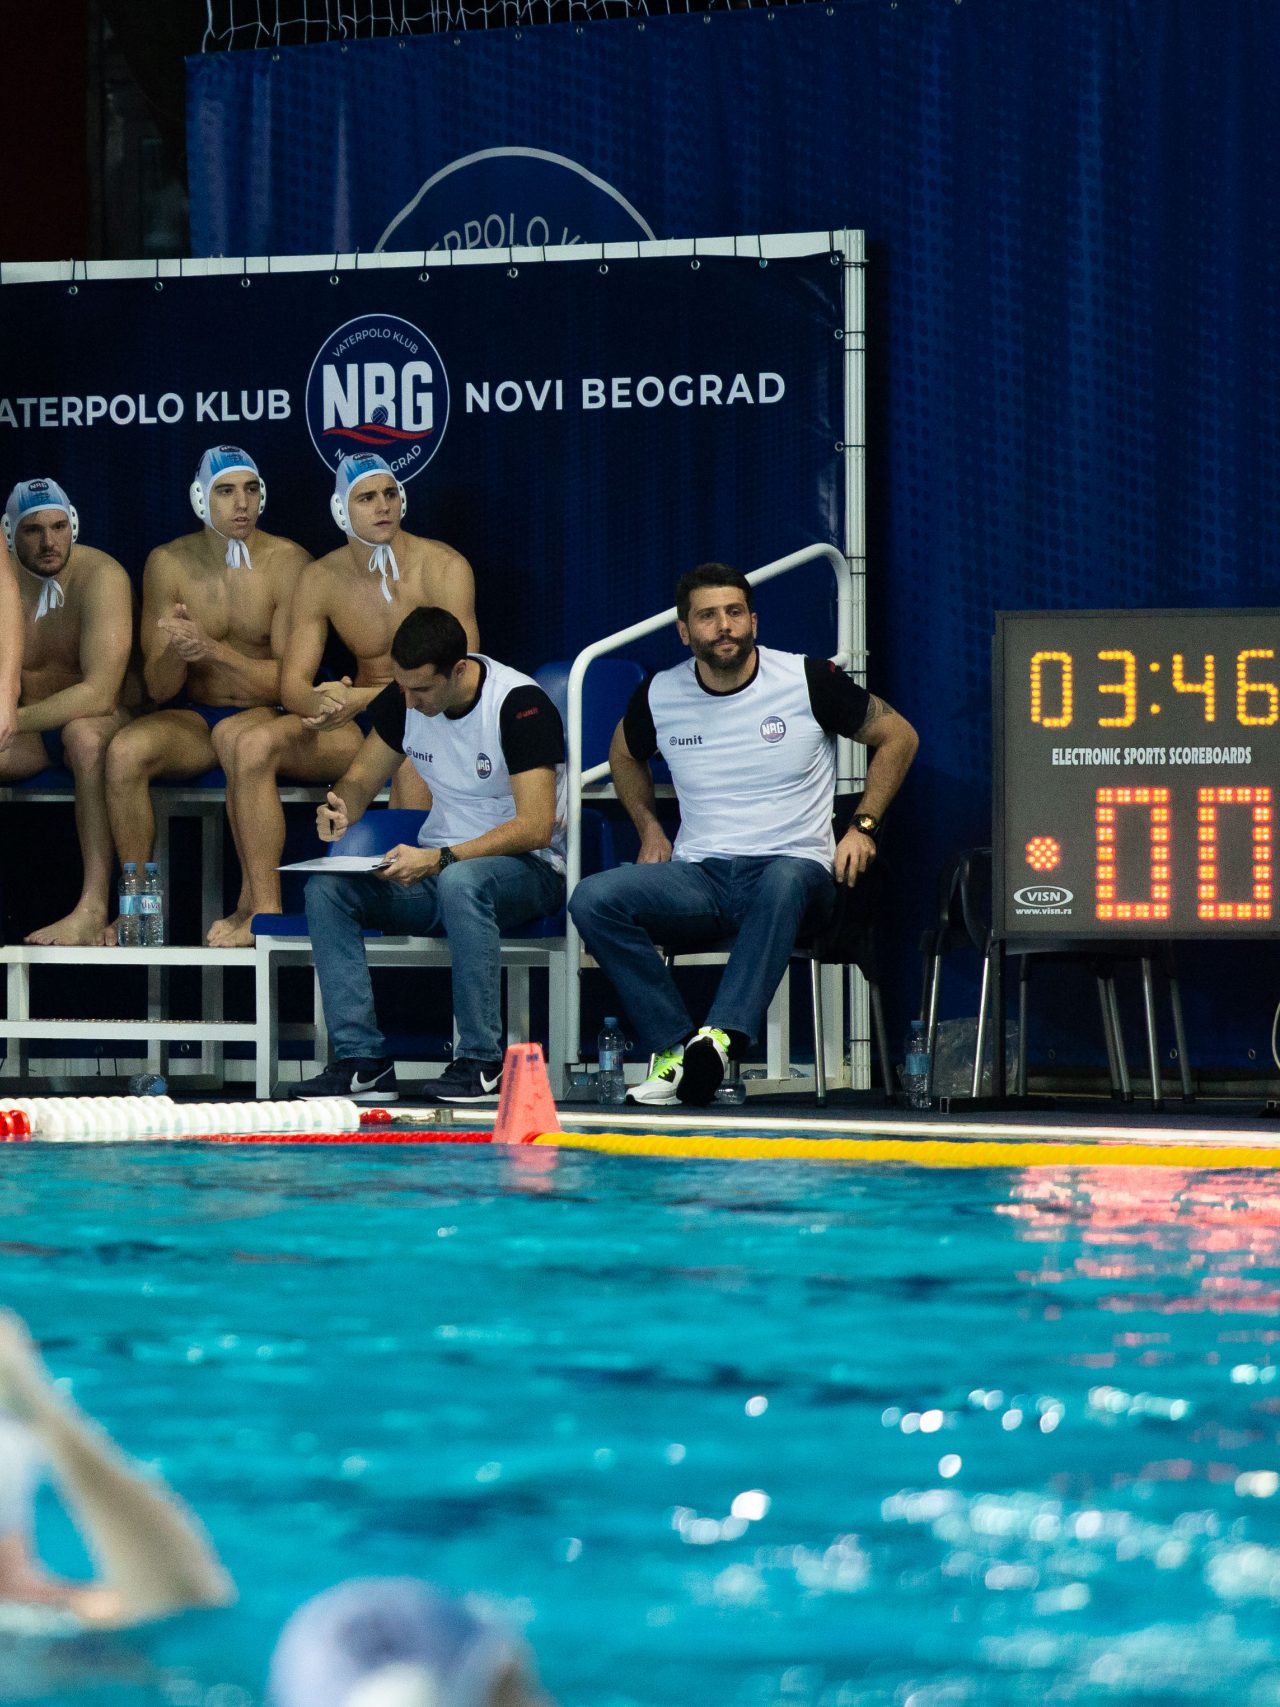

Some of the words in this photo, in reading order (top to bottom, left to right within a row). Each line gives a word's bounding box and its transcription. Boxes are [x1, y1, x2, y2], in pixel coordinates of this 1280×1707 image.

[332, 328, 391, 357] VATERPOLO
[393, 331, 419, 355] KLUB
[322, 361, 433, 432] NRG
[465, 379, 563, 413] NOVI
[582, 372, 786, 409] BEOGRAD
[196, 389, 291, 422] KLUB
[390, 444, 422, 472] GRAD
[1030, 649, 1279, 728] 03:46
[678, 735, 703, 746] unit
[762, 721, 785, 736] NRG
[412, 750, 433, 763] unit
[1052, 747, 1120, 766] ELECTRONIC
[1124, 747, 1166, 765] SPORTS
[1169, 746, 1252, 765] SCOREBOARDS
[1026, 891, 1061, 902] VISN
[1015, 907, 1072, 915] www.visn.rs
